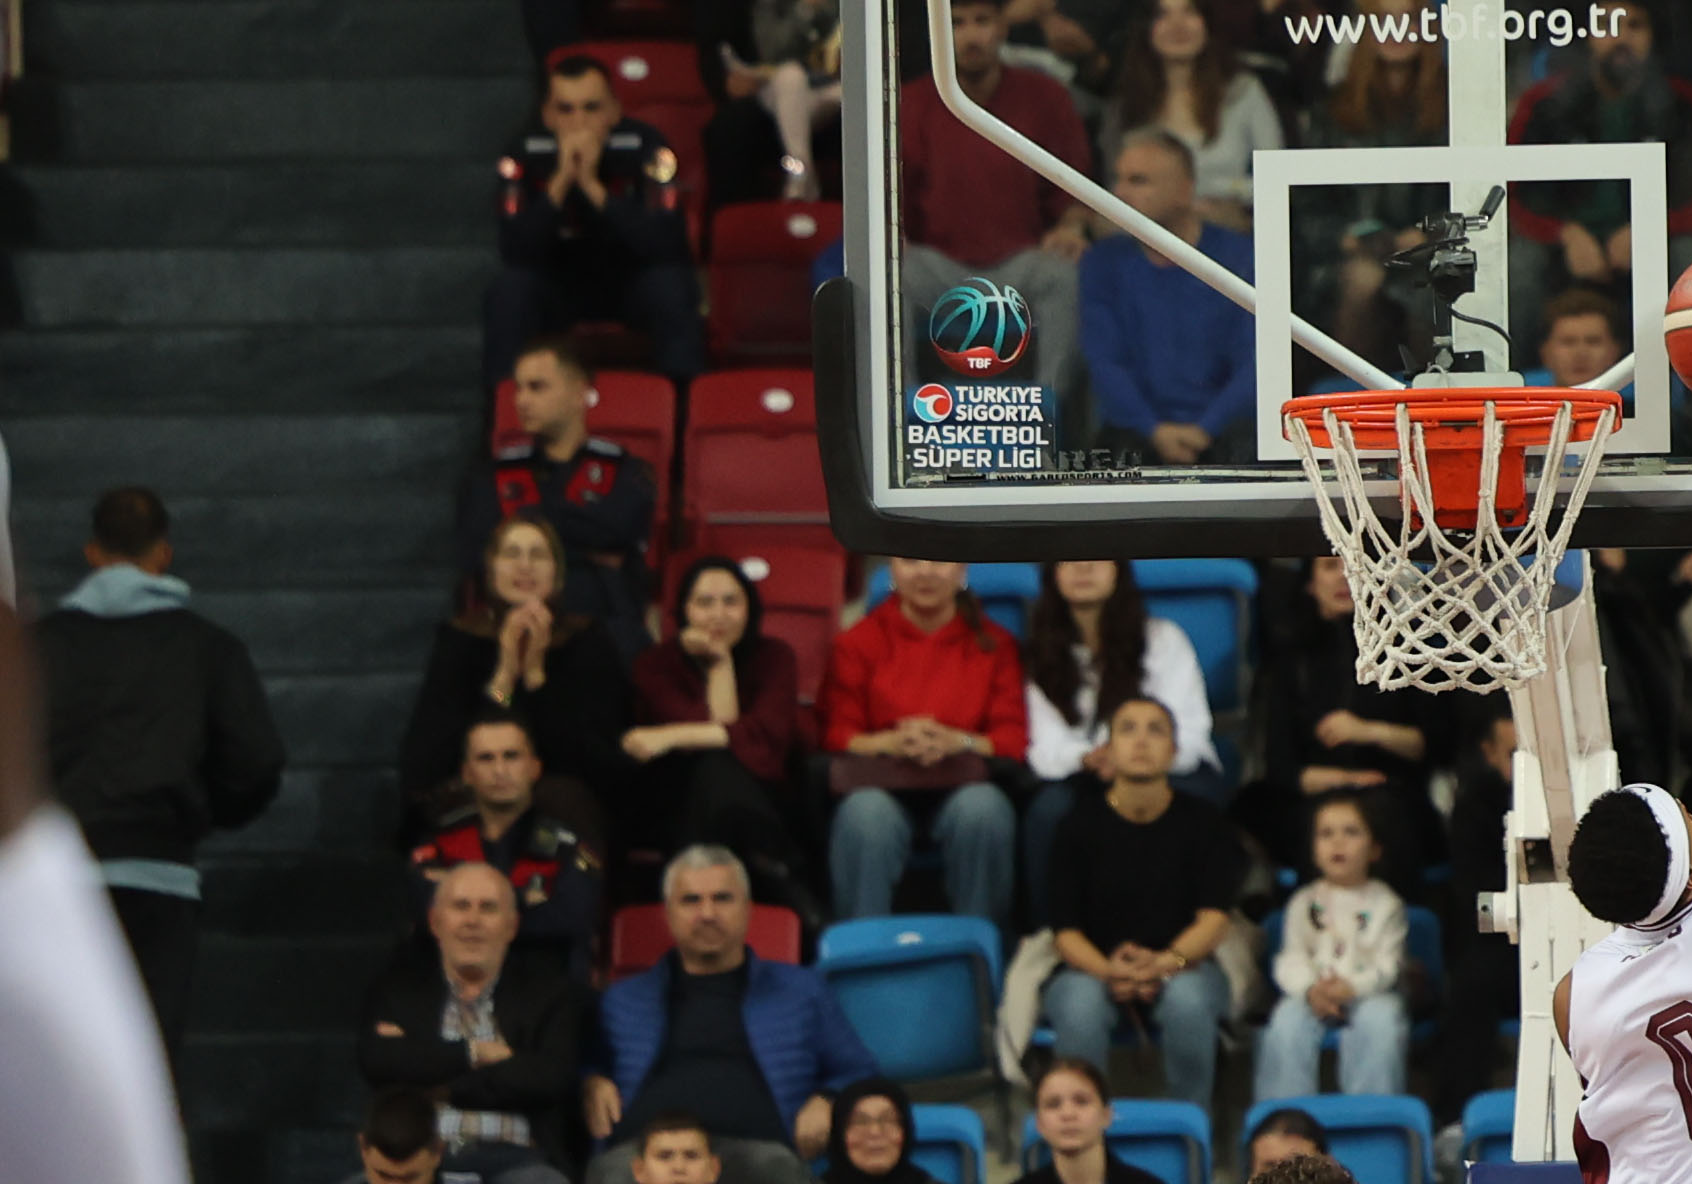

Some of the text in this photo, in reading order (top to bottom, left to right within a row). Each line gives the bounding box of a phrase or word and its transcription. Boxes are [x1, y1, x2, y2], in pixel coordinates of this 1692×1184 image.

[967, 357, 992, 369] TBF
[908, 425, 1049, 444] BASKETBOL
[913, 445, 992, 468] SÜPER
